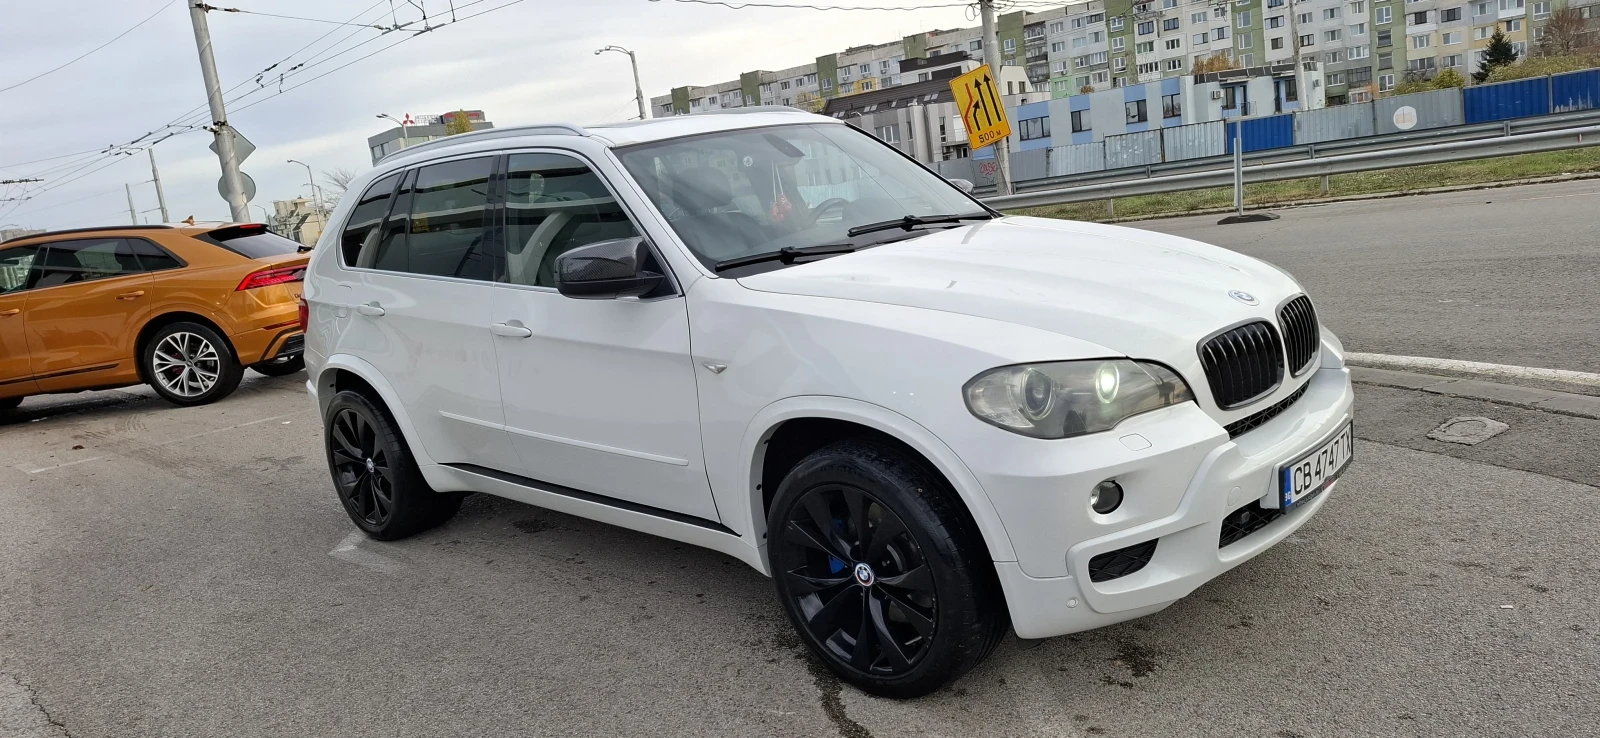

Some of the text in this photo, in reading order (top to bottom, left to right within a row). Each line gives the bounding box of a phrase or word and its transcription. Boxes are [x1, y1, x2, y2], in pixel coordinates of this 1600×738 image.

[979, 130, 995, 143] 500
[1294, 461, 1312, 495] CB
[1314, 439, 1340, 481] 4747
[1341, 427, 1351, 460] TX
